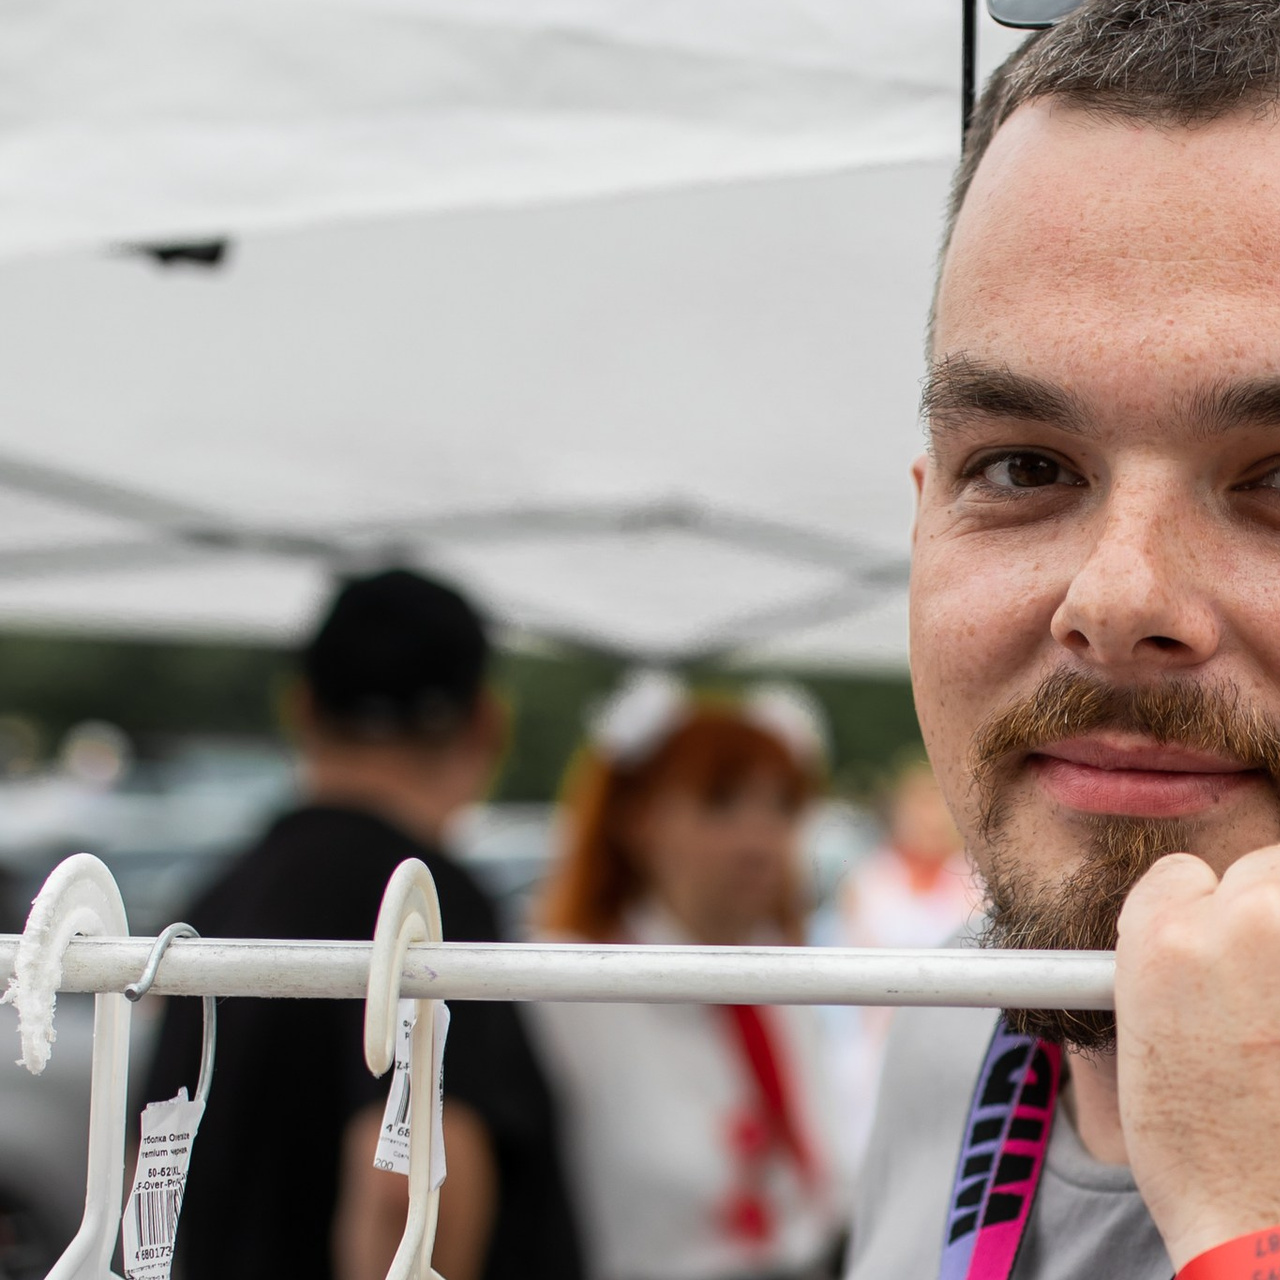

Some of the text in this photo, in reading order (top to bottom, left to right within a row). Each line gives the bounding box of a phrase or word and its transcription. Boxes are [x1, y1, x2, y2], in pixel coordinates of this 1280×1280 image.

[143, 1135, 167, 1144] тболка
[142, 1149, 168, 1158] remium
[141, 1246, 173, 1260] 680173
